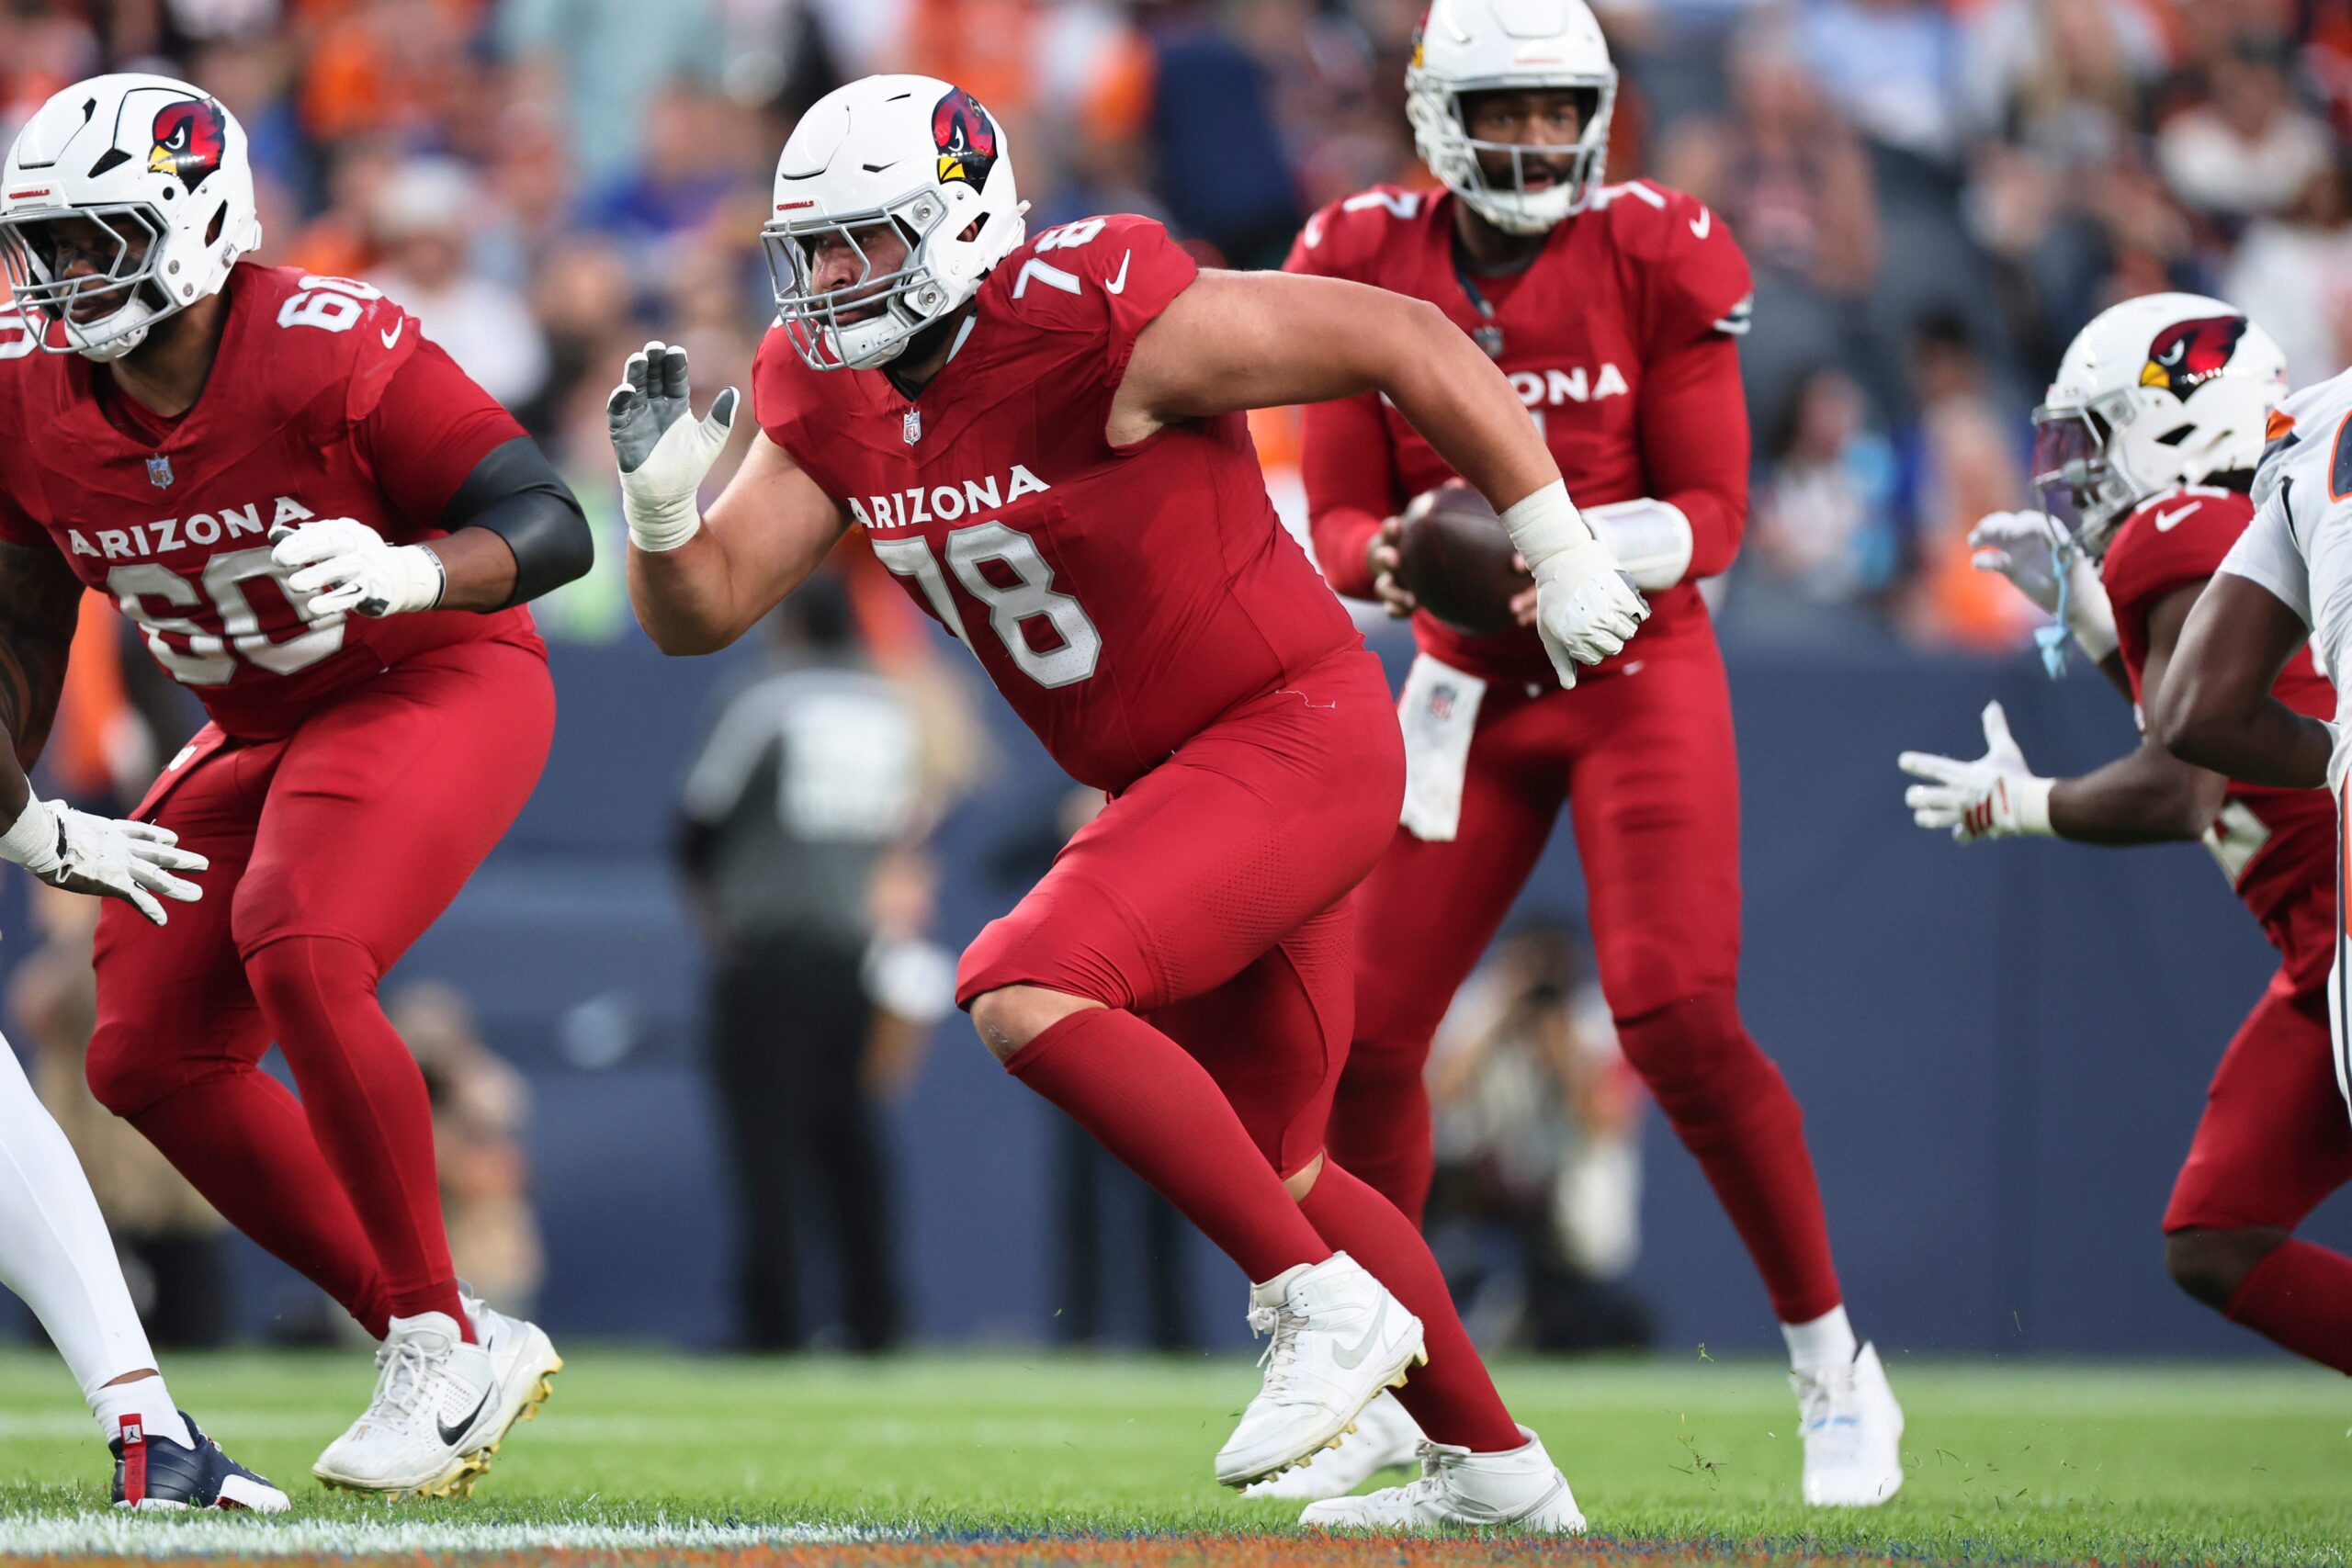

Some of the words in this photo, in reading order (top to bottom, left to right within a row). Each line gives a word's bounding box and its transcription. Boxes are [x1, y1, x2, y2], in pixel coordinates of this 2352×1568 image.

[1012, 218, 1106, 299] 78
[276, 275, 384, 333] 60
[68, 496, 315, 559] ARIZONA
[847, 464, 1051, 529] ARIZONA
[106, 545, 347, 685] 60
[871, 519, 1103, 690] 78
